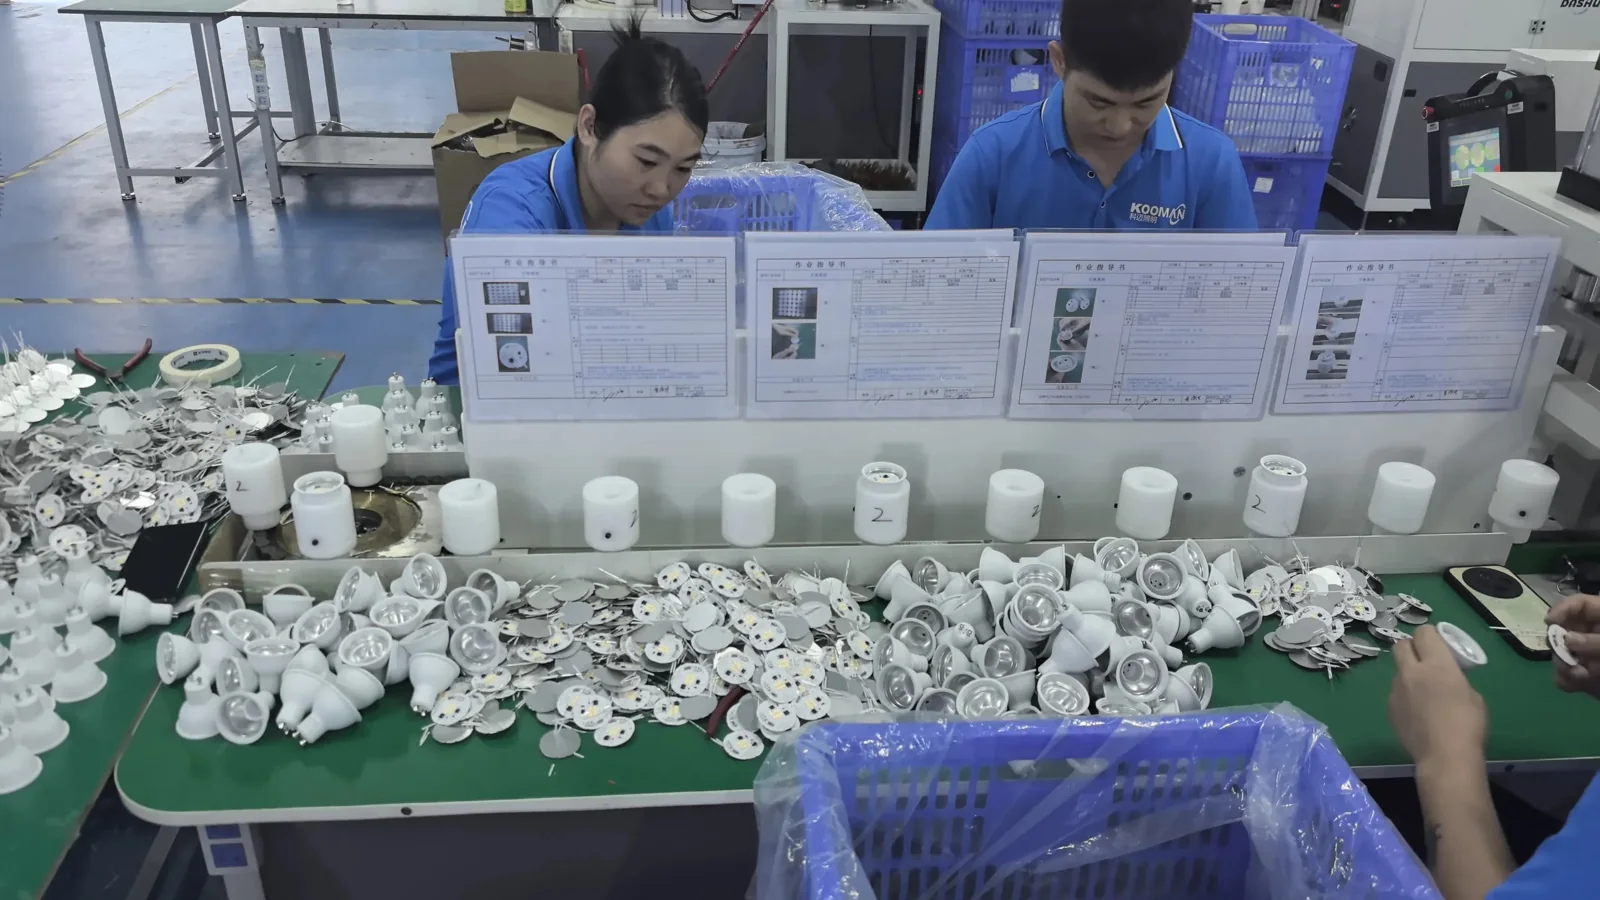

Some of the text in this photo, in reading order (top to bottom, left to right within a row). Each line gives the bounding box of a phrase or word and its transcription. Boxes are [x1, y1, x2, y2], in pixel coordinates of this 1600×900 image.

[1130, 202, 1186, 222] KOOMAN
[794, 261, 847, 269] 作业指导书
[1075, 263, 1126, 271] 作业指导书
[235, 480, 249, 491] 2
[1251, 494, 1267, 514] 2
[871, 507, 893, 523] 2
